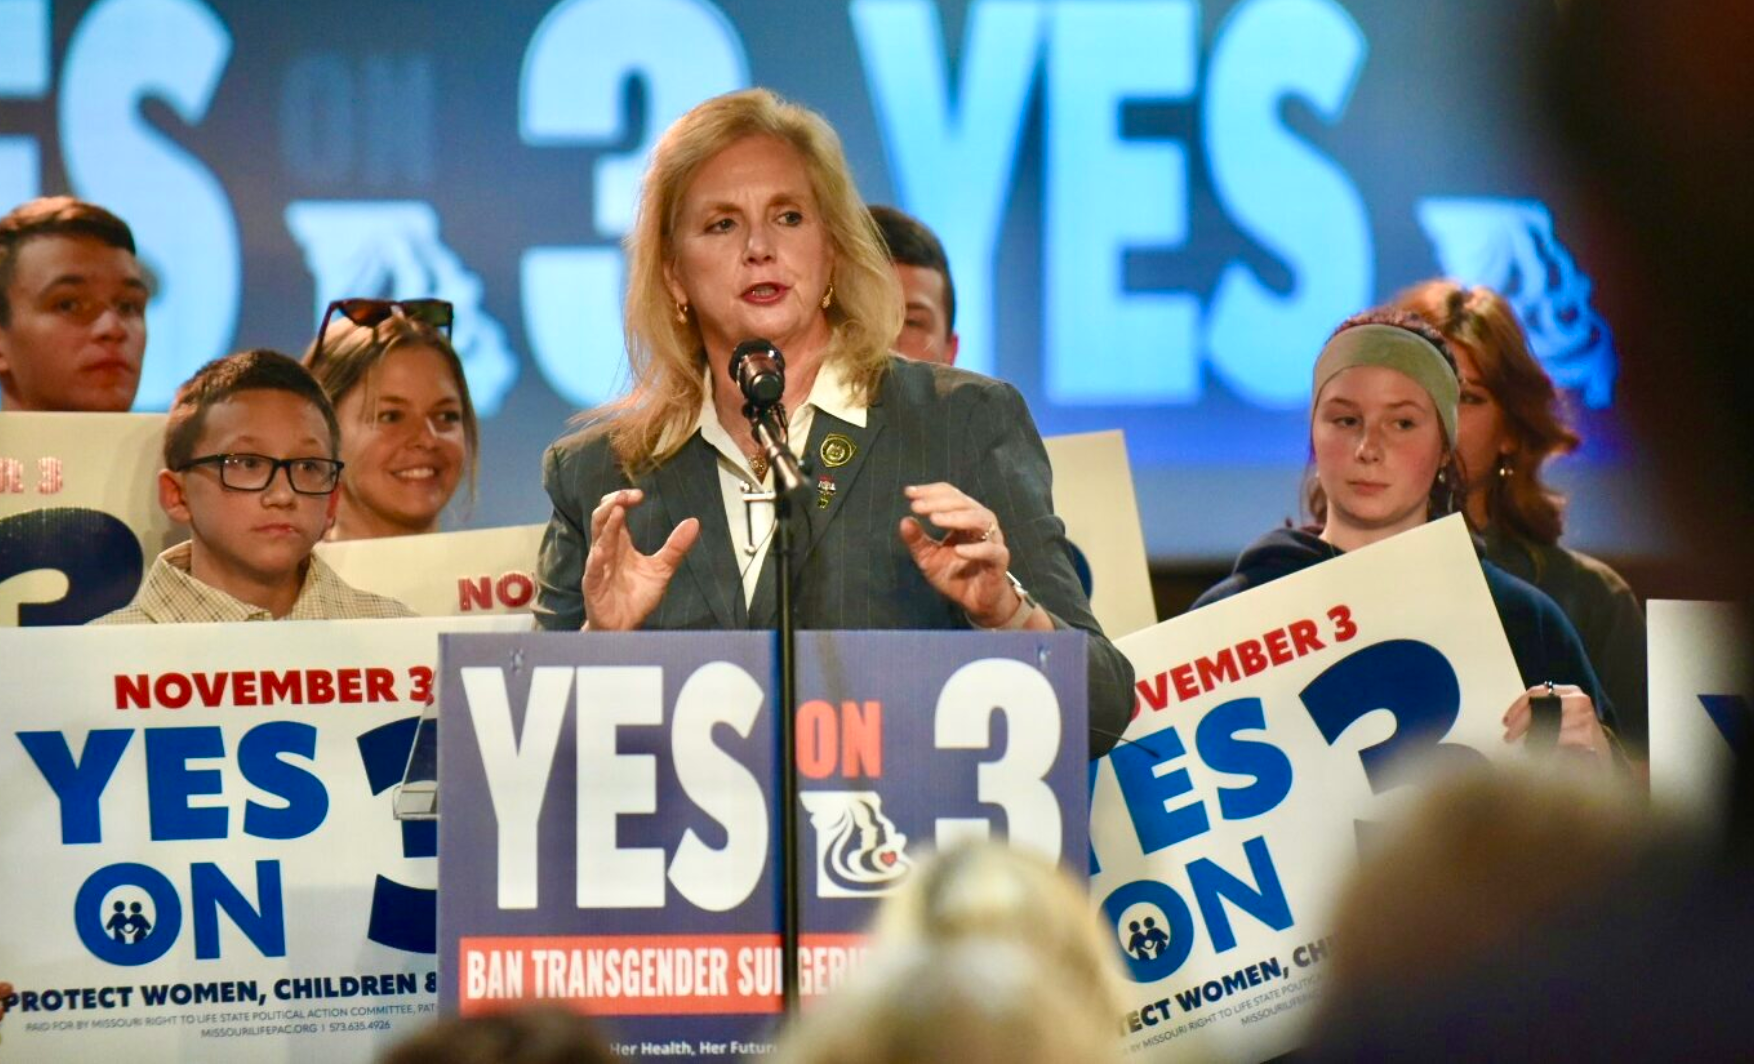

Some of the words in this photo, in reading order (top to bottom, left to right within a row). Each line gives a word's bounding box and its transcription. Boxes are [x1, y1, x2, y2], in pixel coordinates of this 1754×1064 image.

[852, 0, 1373, 410] YES
[114, 668, 399, 709] NOVEMBER
[409, 666, 434, 706] 3
[1133, 619, 1326, 721] VEMBER
[1327, 605, 1357, 642] 3
[15, 721, 329, 844] YES
[461, 661, 769, 911] YES
[796, 700, 881, 779] ON
[935, 658, 1062, 880] 3
[74, 859, 286, 967] ON
[1098, 836, 1295, 983] ON
[3, 986, 133, 1013] PROTECT
[140, 980, 267, 1006] WOMEN,
[274, 973, 417, 1000] CHILDREN
[468, 950, 523, 1000] BAN
[531, 948, 729, 999] TRANSGENDER
[1175, 957, 1289, 1012] WOMEN,
[1253, 988, 1281, 1006] STATE
[76, 1020, 90, 1030] BY
[91, 1017, 143, 1029] MISSOURI
[146, 1015, 177, 1025] RIGHT
[181, 1014, 195, 1024] TO
[197, 1013, 217, 1023] LIFE
[220, 1012, 250, 1022] STATE
[253, 1010, 304, 1021] POLITICAL
[308, 1008, 348, 1018] ACTION
[350, 1005, 416, 1017] COMMITTEE,
[201, 1022, 318, 1038] MISSOURILIFEPAC.ORG
[329, 1020, 391, 1033] 573.635.4926
[610, 1042, 638, 1056] Her
[640, 1041, 696, 1057] Health,
[699, 1041, 727, 1055] Her
